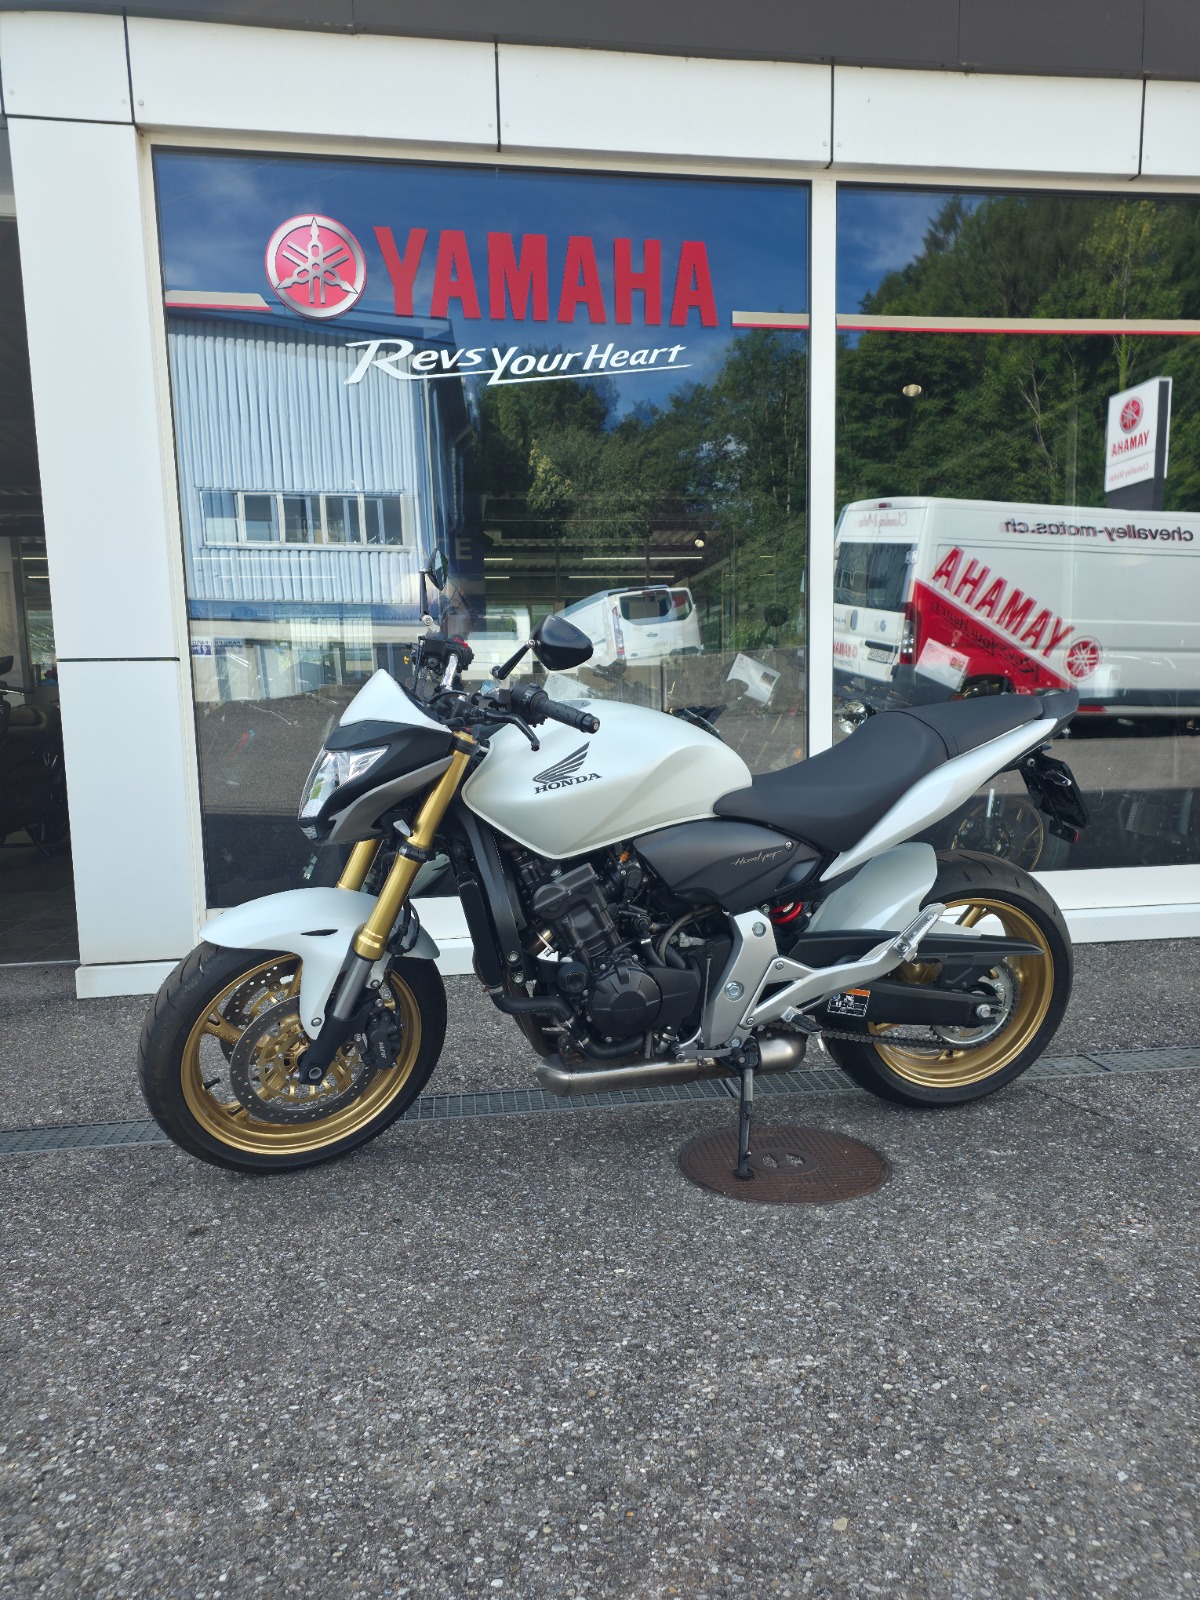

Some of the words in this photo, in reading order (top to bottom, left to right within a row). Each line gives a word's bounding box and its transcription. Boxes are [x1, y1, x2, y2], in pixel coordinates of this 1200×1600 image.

[373, 226, 719, 327] YAMAHA
[344, 338, 487, 385] Revs
[486, 345, 583, 385] Your
[581, 343, 687, 372] Heart
[534, 772, 602, 795] HONDA
